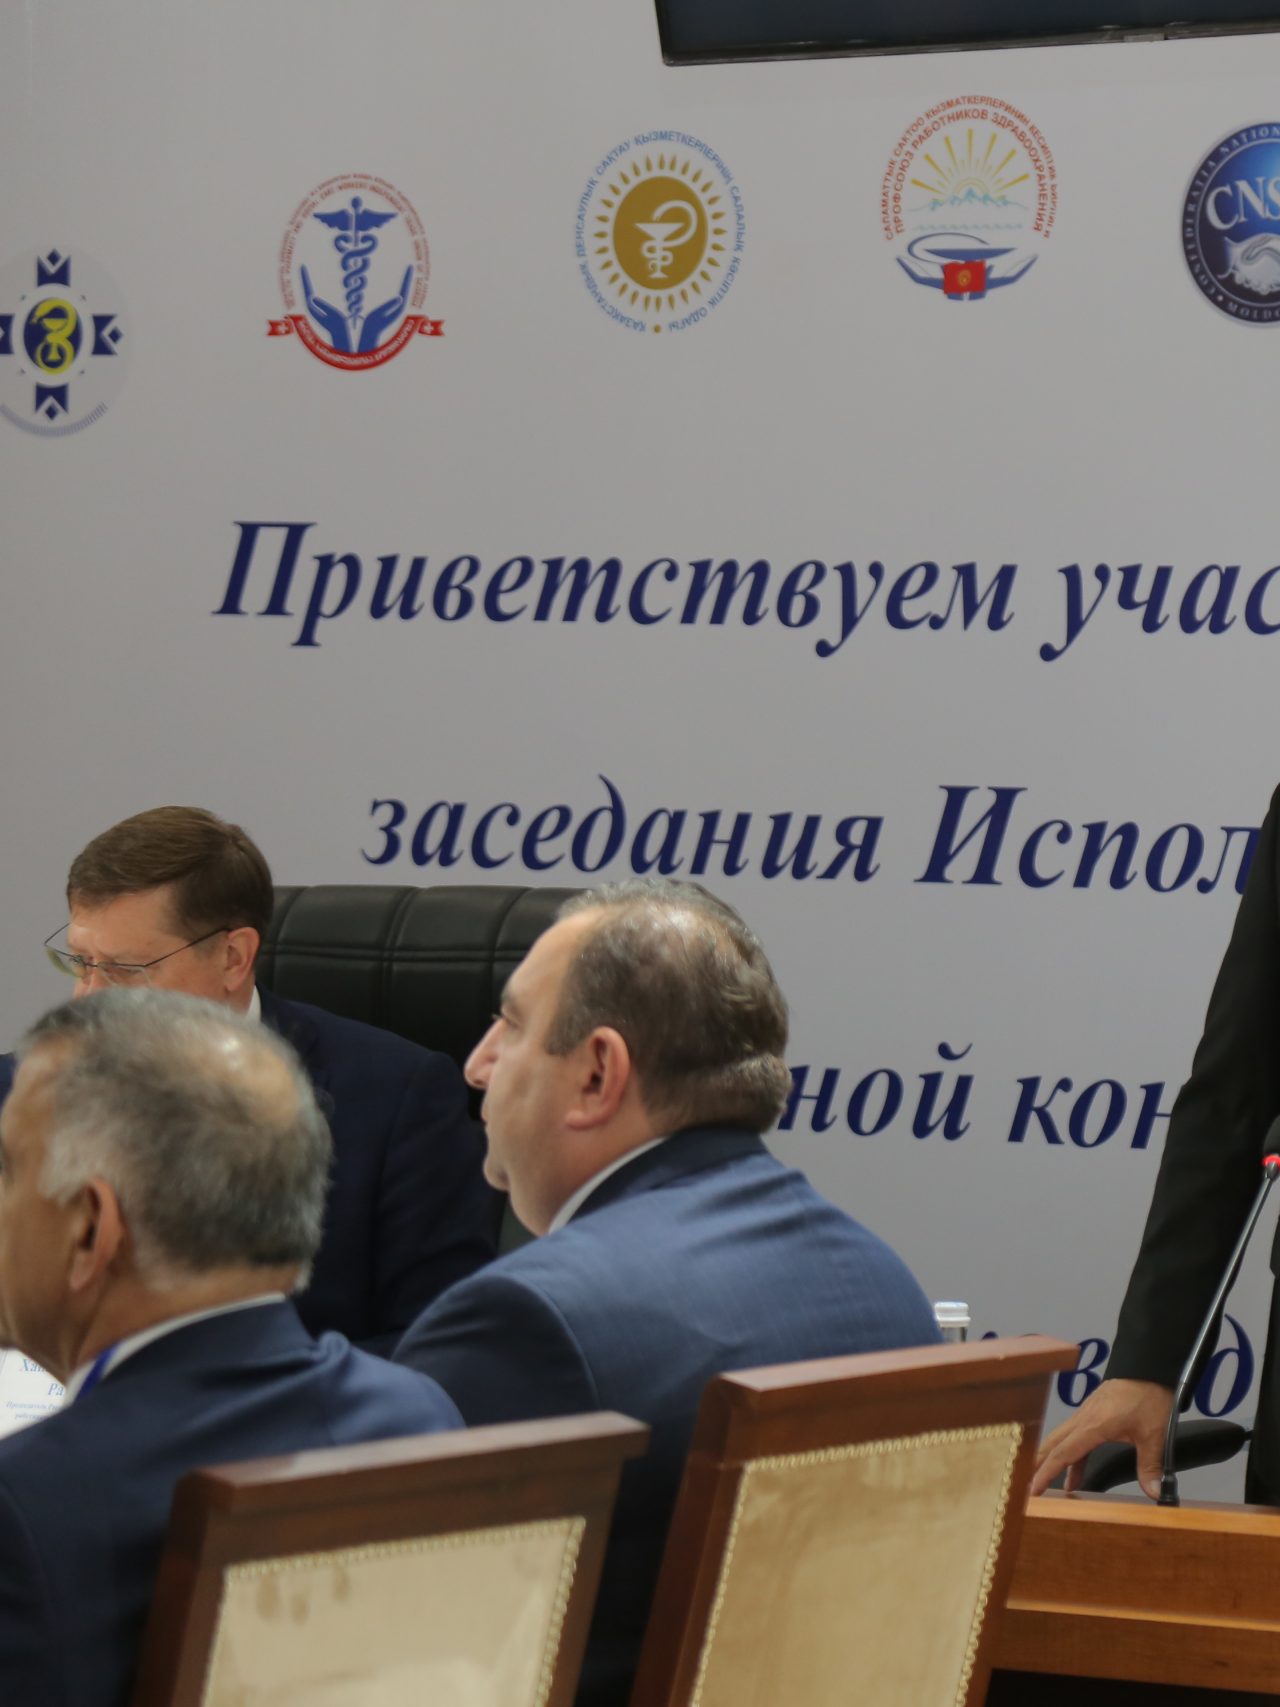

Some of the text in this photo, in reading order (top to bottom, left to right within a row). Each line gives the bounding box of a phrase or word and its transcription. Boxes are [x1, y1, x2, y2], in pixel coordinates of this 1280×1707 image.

[912, 108, 989, 151] РАБОТНИКОВ
[210, 520, 1018, 658] Приветствуем
[361, 773, 1263, 896] заседания Испол
